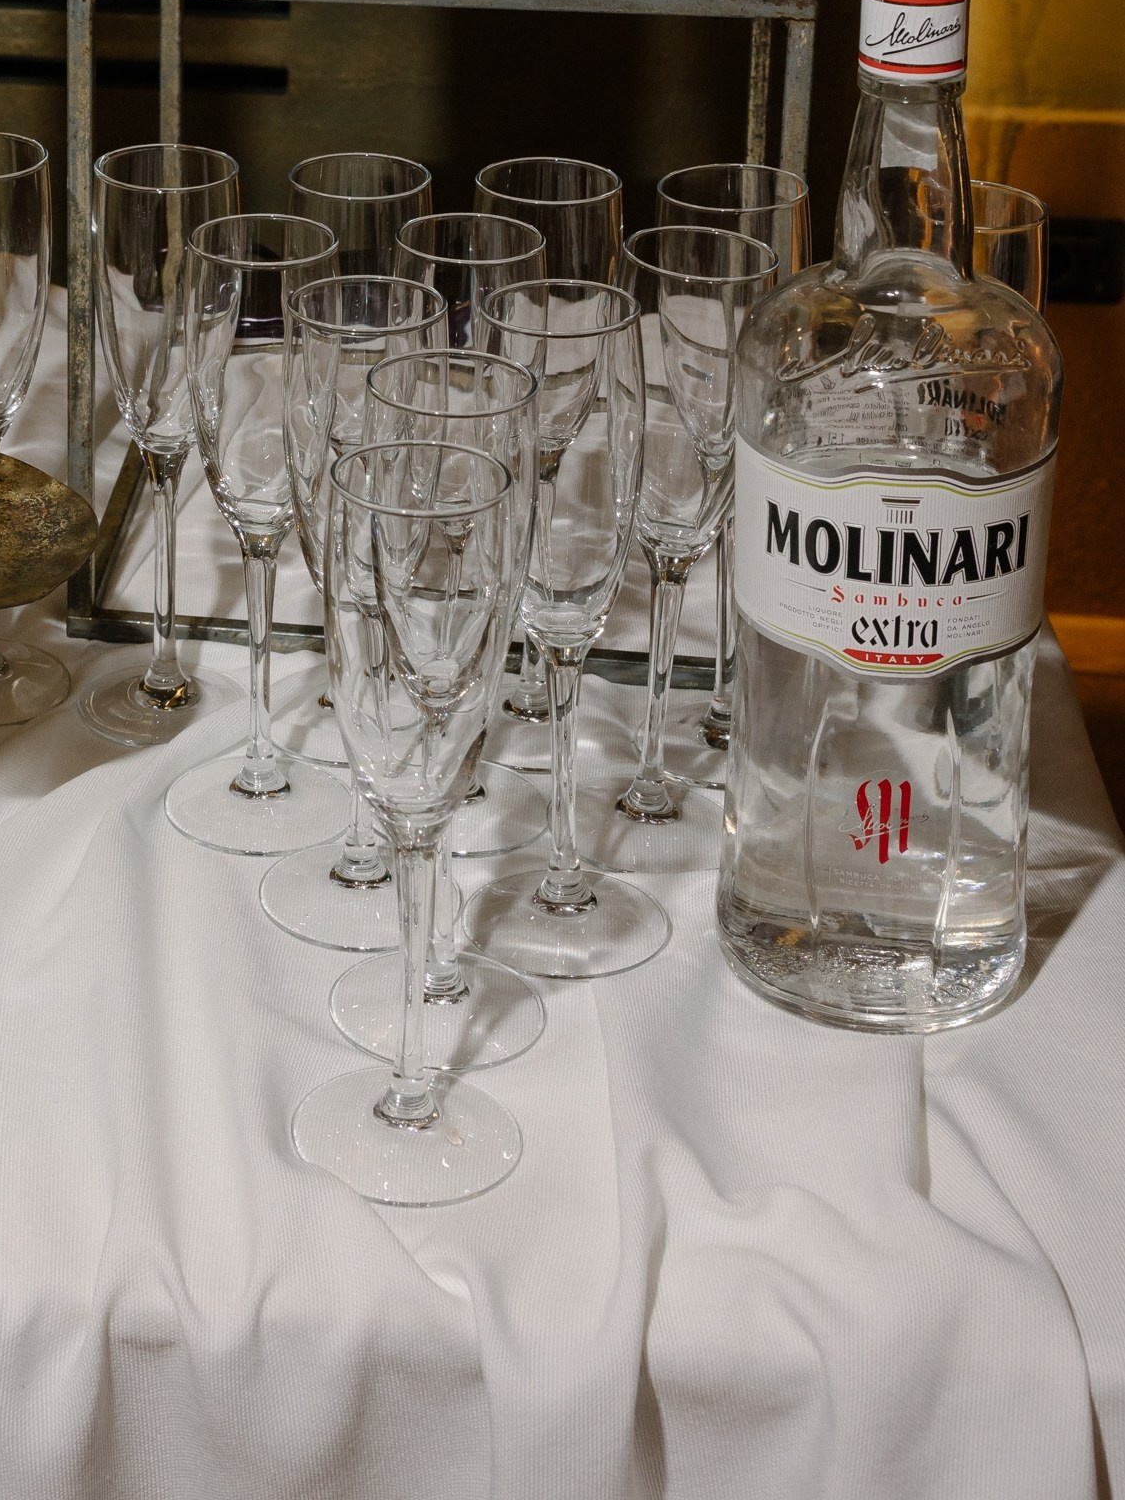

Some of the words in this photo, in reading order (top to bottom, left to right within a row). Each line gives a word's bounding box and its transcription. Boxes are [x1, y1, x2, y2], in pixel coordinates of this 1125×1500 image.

[765, 497, 1031, 588] MOLINARI
[831, 585, 962, 608] Sambuca
[779, 601, 815, 619] PRODOTTO
[819, 615, 843, 625] NEGLI
[808, 604, 843, 618] LIQUORE
[947, 615, 981, 624] FONDATI
[961, 620, 991, 630] ANGELO
[812, 621, 842, 633] OPIFICI
[851, 614, 939, 649] extra
[947, 629, 983, 639] MOLINARI
[865, 653, 925, 664] ITALY
[833, 868, 880, 881] SAMBUCA
[839, 878, 874, 889] RICETTA
